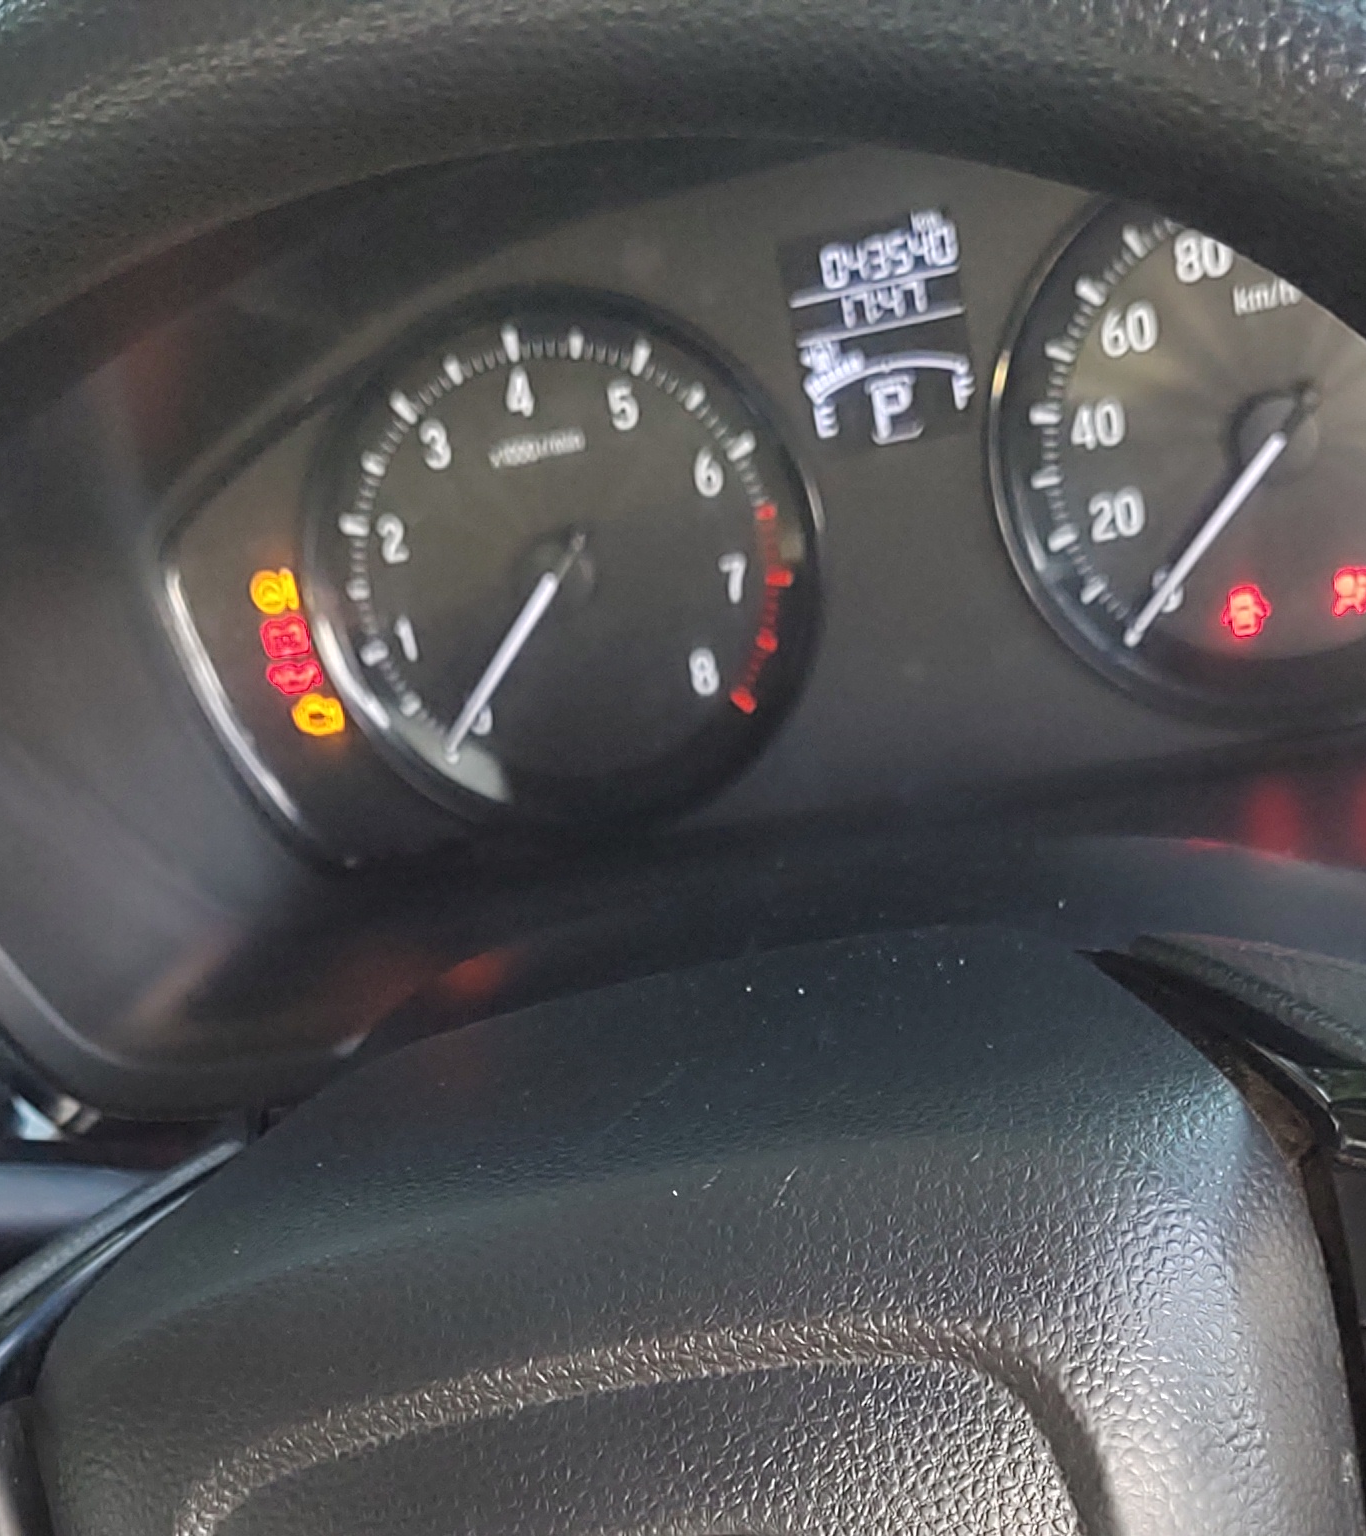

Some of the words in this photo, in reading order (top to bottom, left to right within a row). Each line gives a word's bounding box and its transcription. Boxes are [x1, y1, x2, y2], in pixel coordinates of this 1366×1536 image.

[1174, 229, 1234, 284] 80
[1101, 301, 1158, 358] 60
[506, 366, 534, 417] 4
[607, 379, 638, 431] 5
[871, 378, 914, 440] P
[420, 419, 451, 471] 3
[1071, 396, 1125, 450] 40
[695, 446, 724, 498] 6
[377, 513, 408, 564] 2
[1089, 486, 1145, 543] 20
[718, 552, 746, 604] 7
[394, 614, 418, 663] 1
[688, 648, 720, 698] 8
